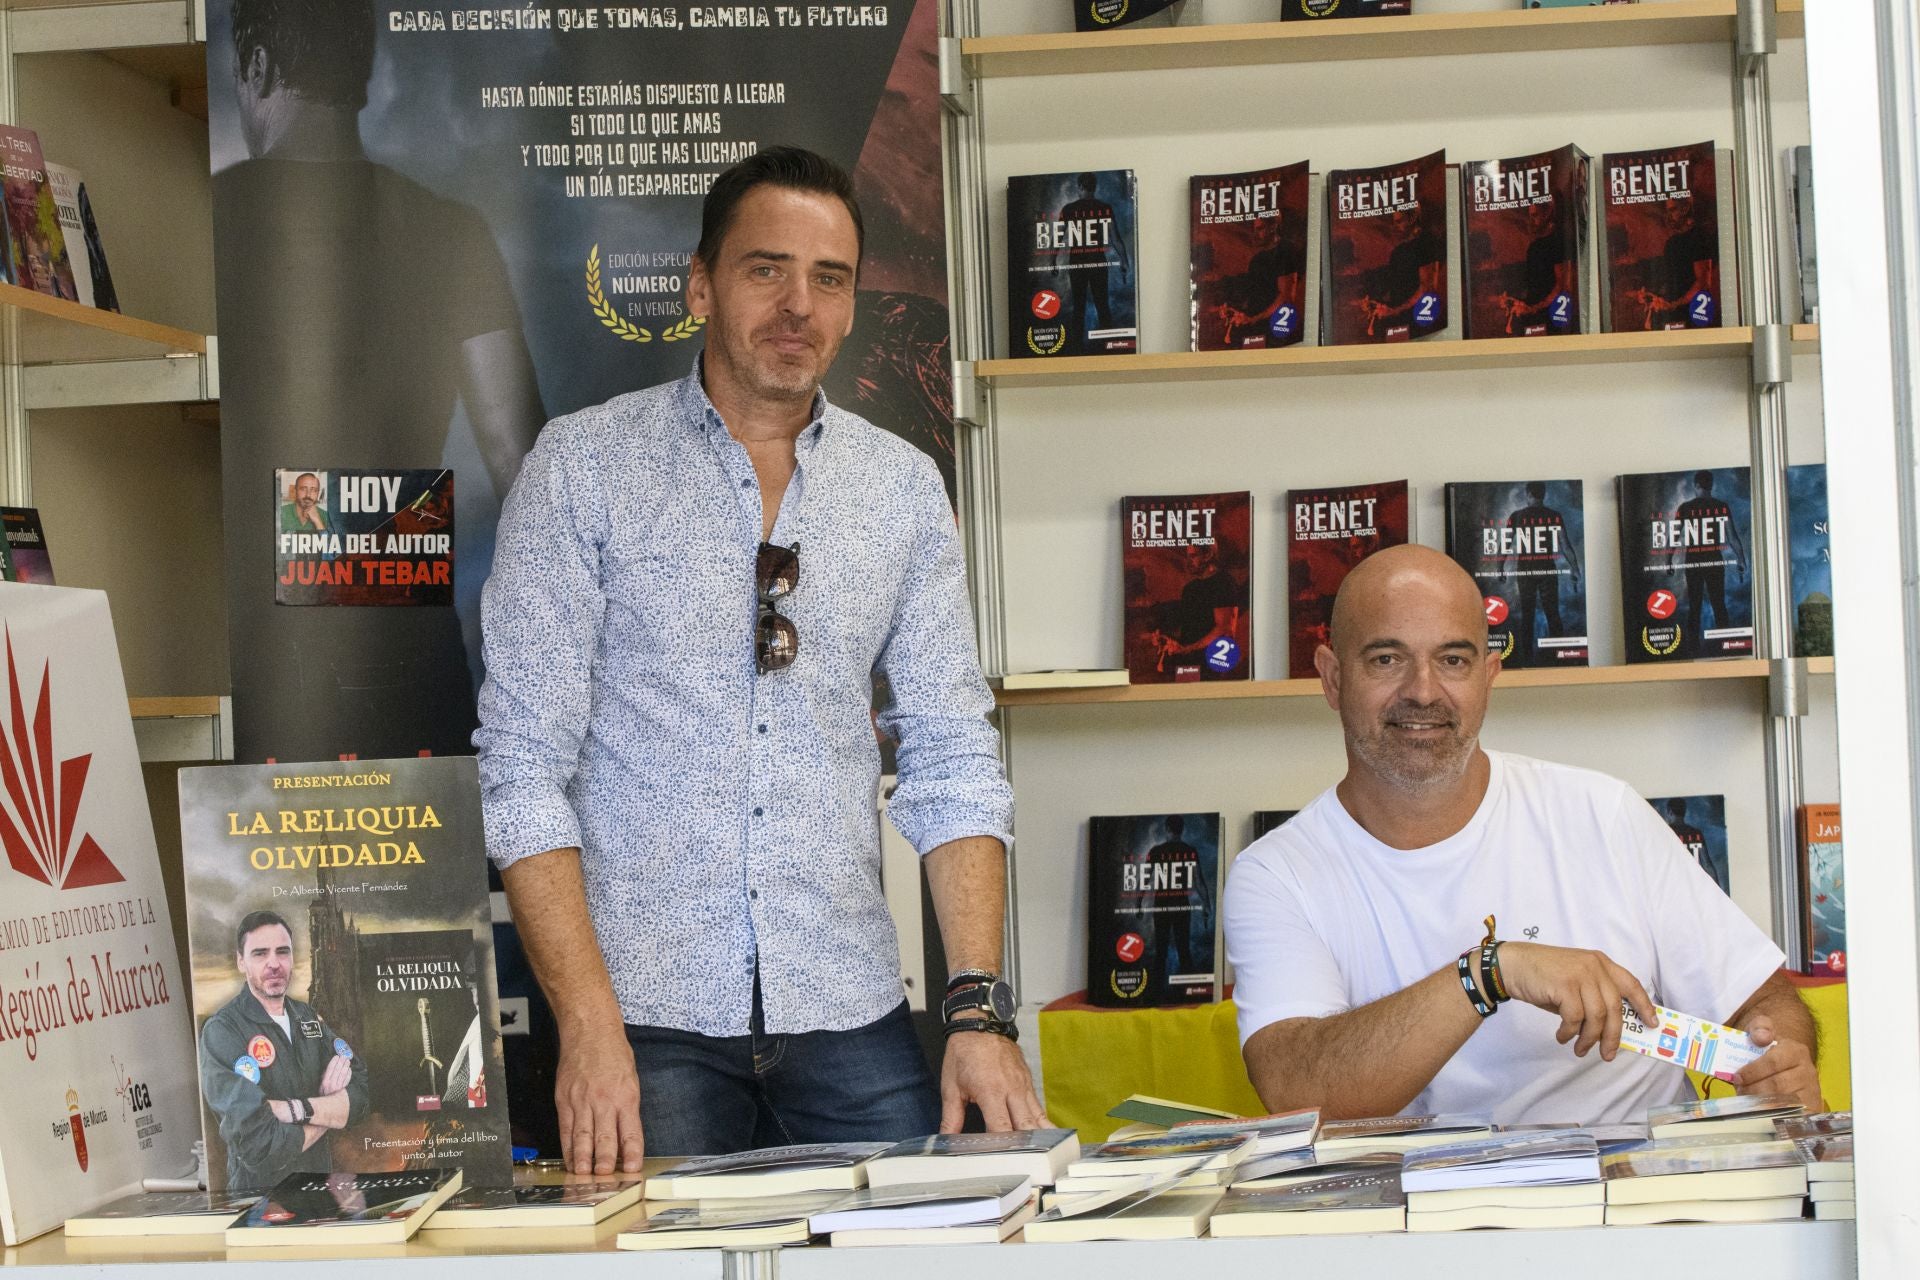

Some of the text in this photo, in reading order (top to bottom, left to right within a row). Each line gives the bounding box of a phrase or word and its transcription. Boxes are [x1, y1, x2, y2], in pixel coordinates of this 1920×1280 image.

[389, 2, 888, 32] CADA DECISIÓN QUE TOMAS, CAMBIA TU FUTURO
[482, 80, 785, 108] HASTA DÓNDE ESTARÍAS DISPUESTO A LLEGAR
[571, 112, 721, 137] SI TODO LO QUE AMAS
[6, 136, 32, 154] TREN
[520, 145, 530, 166] Y
[534, 144, 570, 166] TODO
[575, 144, 602, 166] POR
[608, 144, 624, 165] LO
[630, 143, 657, 168] QUE
[662, 142, 689, 164] HAS
[565, 176, 584, 198] UN
[590, 168, 614, 197] DÍA
[1338, 173, 1418, 212] BENET
[1474, 165, 1552, 204] BENET
[1610, 160, 1689, 197] BENET
[1200, 180, 1280, 216] BENET
[1475, 204, 1487, 212] LOS
[1520, 199, 1531, 208] DEL
[1612, 197, 1624, 205] LOS
[1657, 193, 1668, 201] DEL
[1200, 216, 1213, 224] LOS
[1245, 213, 1256, 221] DEL
[1339, 212, 1352, 220] LOS
[1384, 207, 1395, 215] DEL
[1036, 218, 1112, 249] BENET
[608, 250, 694, 268] EDICIÓN ESPECIA
[612, 273, 680, 294] NÚMERO
[629, 301, 682, 316] EN VENTAS
[340, 476, 402, 513] HOY
[1132, 509, 1216, 539] BENET
[1295, 498, 1376, 532] BENET
[280, 534, 450, 554] FIRMA DEL AUTOR
[1341, 530, 1352, 538] DEL
[1483, 526, 1562, 555] BENET
[1652, 516, 1728, 549] BENET
[280, 560, 450, 585] JUAN TEBAR
[273, 770, 390, 789] PRESENTACIÓN
[228, 805, 442, 836] LA RELIQUIA
[250, 842, 425, 870] OLVIDADA
[272, 882, 408, 897] De Alberto Vicente Fernández
[1123, 861, 1197, 892] BENET
[32, 916, 50, 944] DE
[52, 903, 116, 939] EDITORES
[118, 900, 136, 928] DE
[138, 897, 156, 924] LA
[376, 961, 461, 976] LA RELIQUIA
[66, 955, 94, 1024] de
[91, 944, 170, 1018] Murcia
[377, 975, 462, 992] OLVIDADA
[129, 1083, 152, 1112] ica
[52, 1120, 70, 1140] Región
[83, 1112, 90, 1128] de
[364, 1131, 498, 1150] Presentación y firma del libro
[401, 1148, 463, 1166] junto al autor
